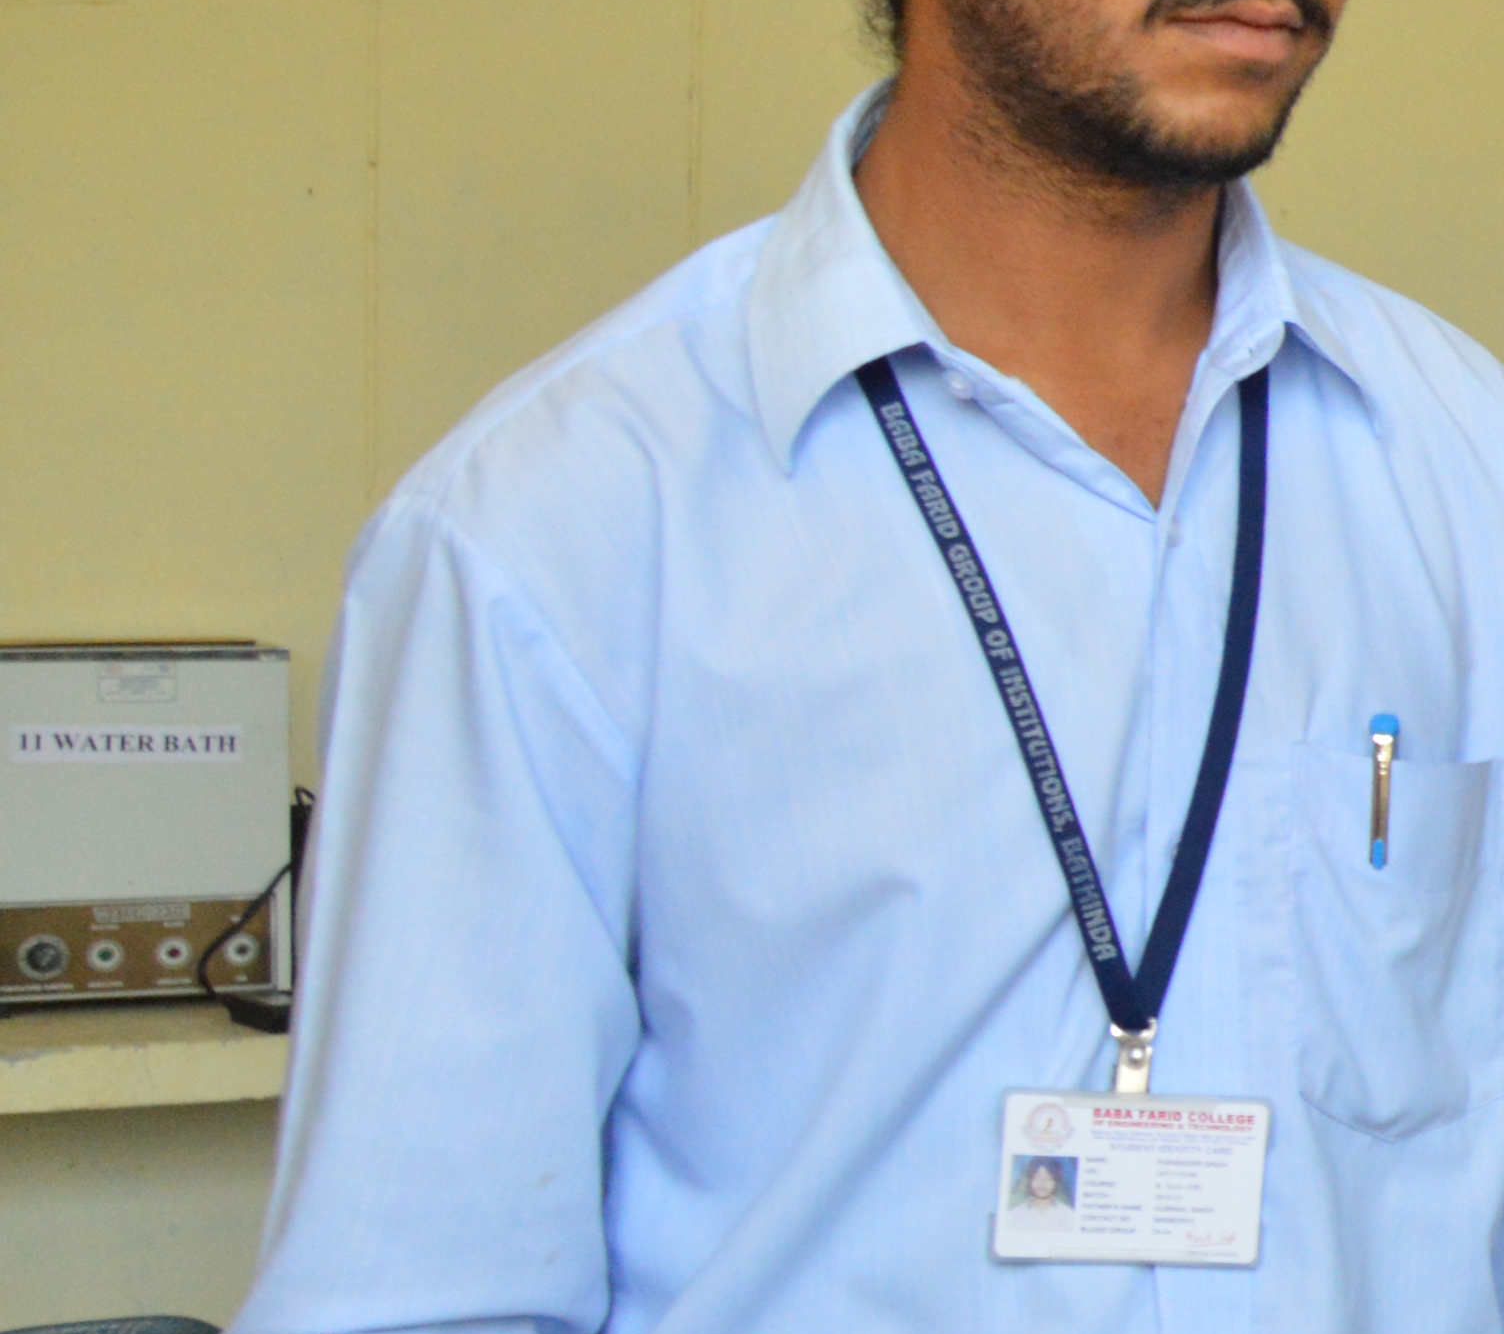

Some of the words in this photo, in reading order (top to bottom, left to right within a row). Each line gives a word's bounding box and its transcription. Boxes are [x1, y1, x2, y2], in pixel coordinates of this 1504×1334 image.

[879, 401, 928, 467] BABA
[910, 469, 960, 539] FARID
[947, 543, 999, 624] GROUP
[984, 630, 1016, 660] OF
[1061, 836, 1118, 962] BATHINDA
[52, 733, 154, 752] WATER
[163, 734, 237, 753] BATH
[1093, 1108, 1133, 1120] BABA
[1138, 1109, 1183, 1122] FARID
[1188, 1112, 1256, 1125] COLLEGE
[1110, 1143, 1155, 1152] STUDENT
[1206, 1146, 1233, 1156] CARD
